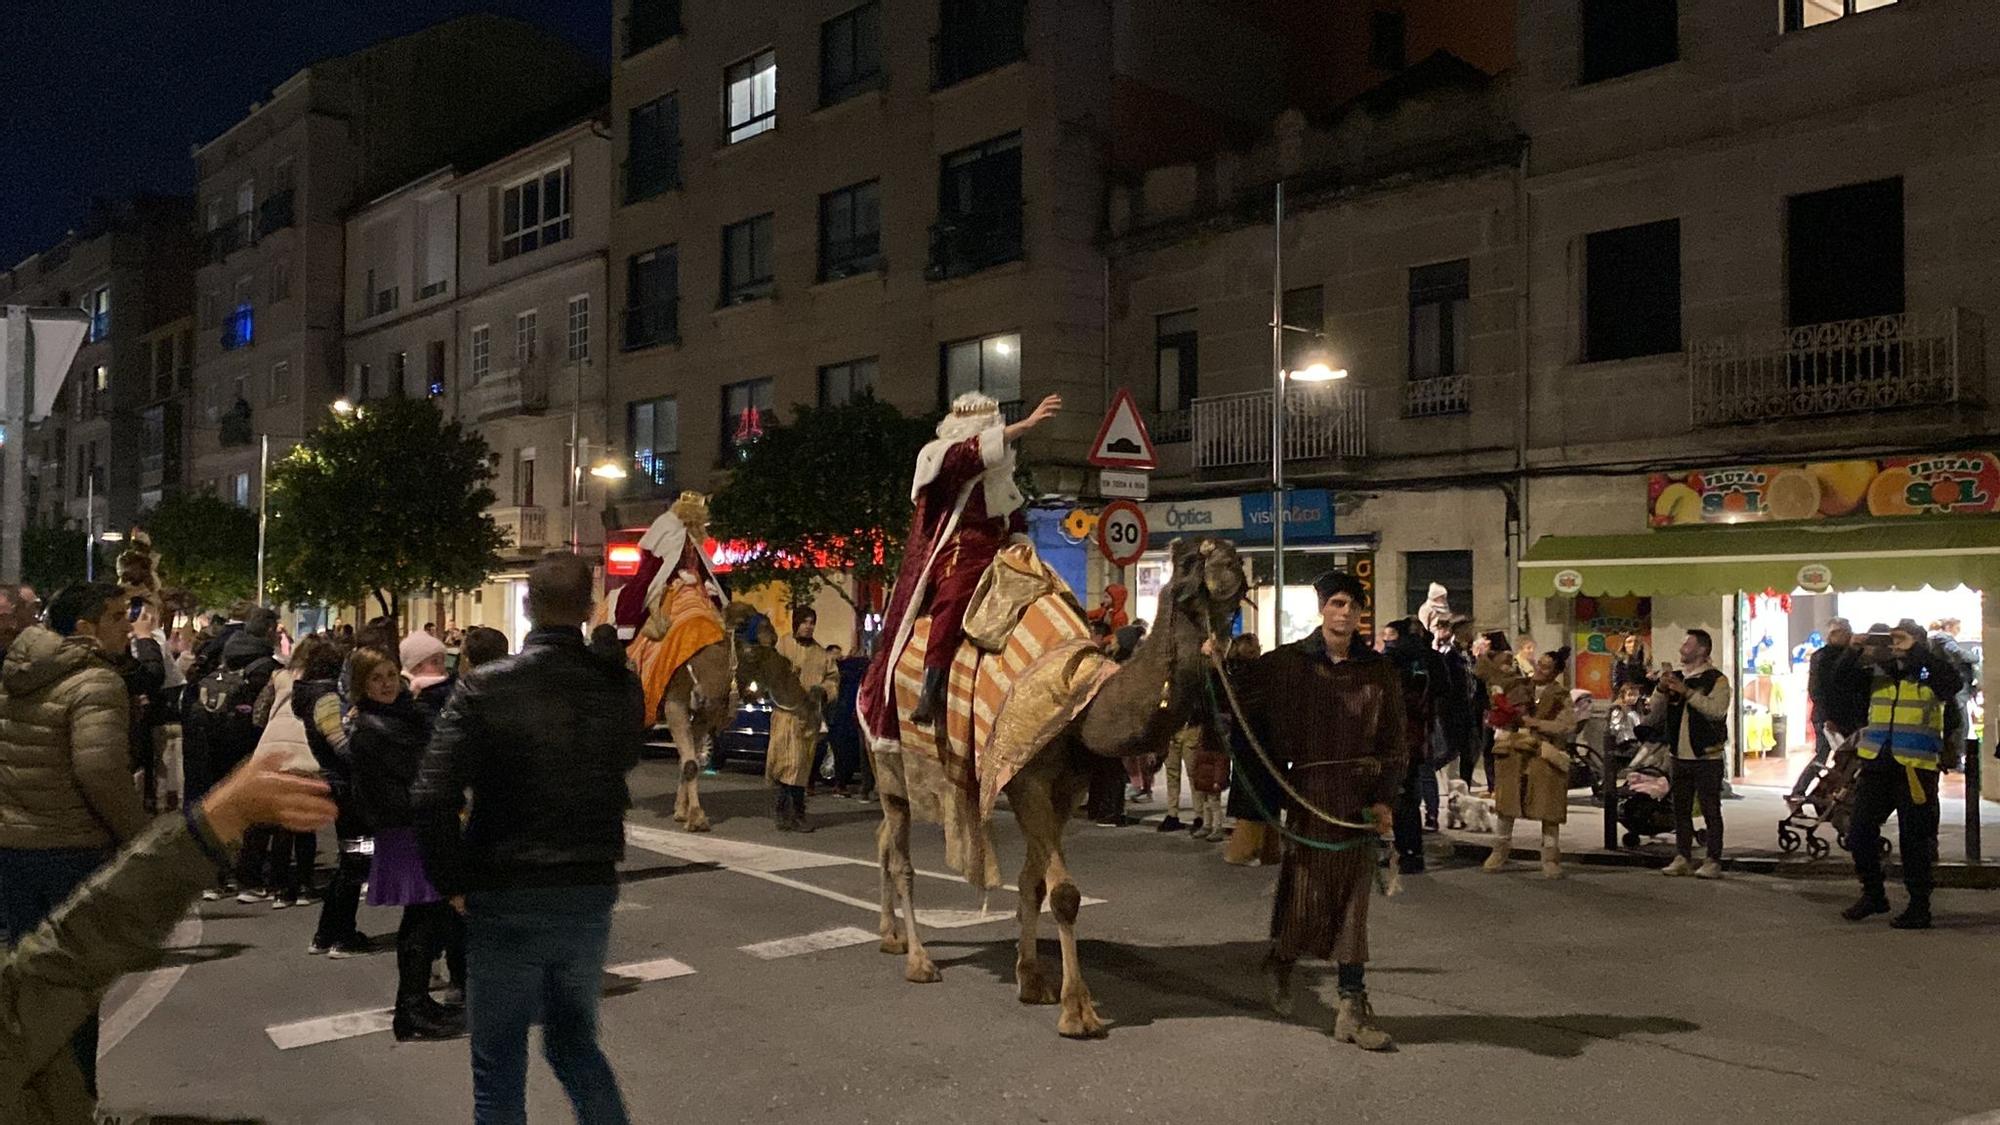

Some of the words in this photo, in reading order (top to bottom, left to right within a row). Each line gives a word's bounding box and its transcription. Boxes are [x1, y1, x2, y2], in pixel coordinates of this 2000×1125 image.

[1704, 468, 1767, 488] FRUTAS
[1907, 459, 1983, 476] FRUTAS
[1166, 504, 1213, 529] Óptica
[1110, 522, 1138, 544] 30
